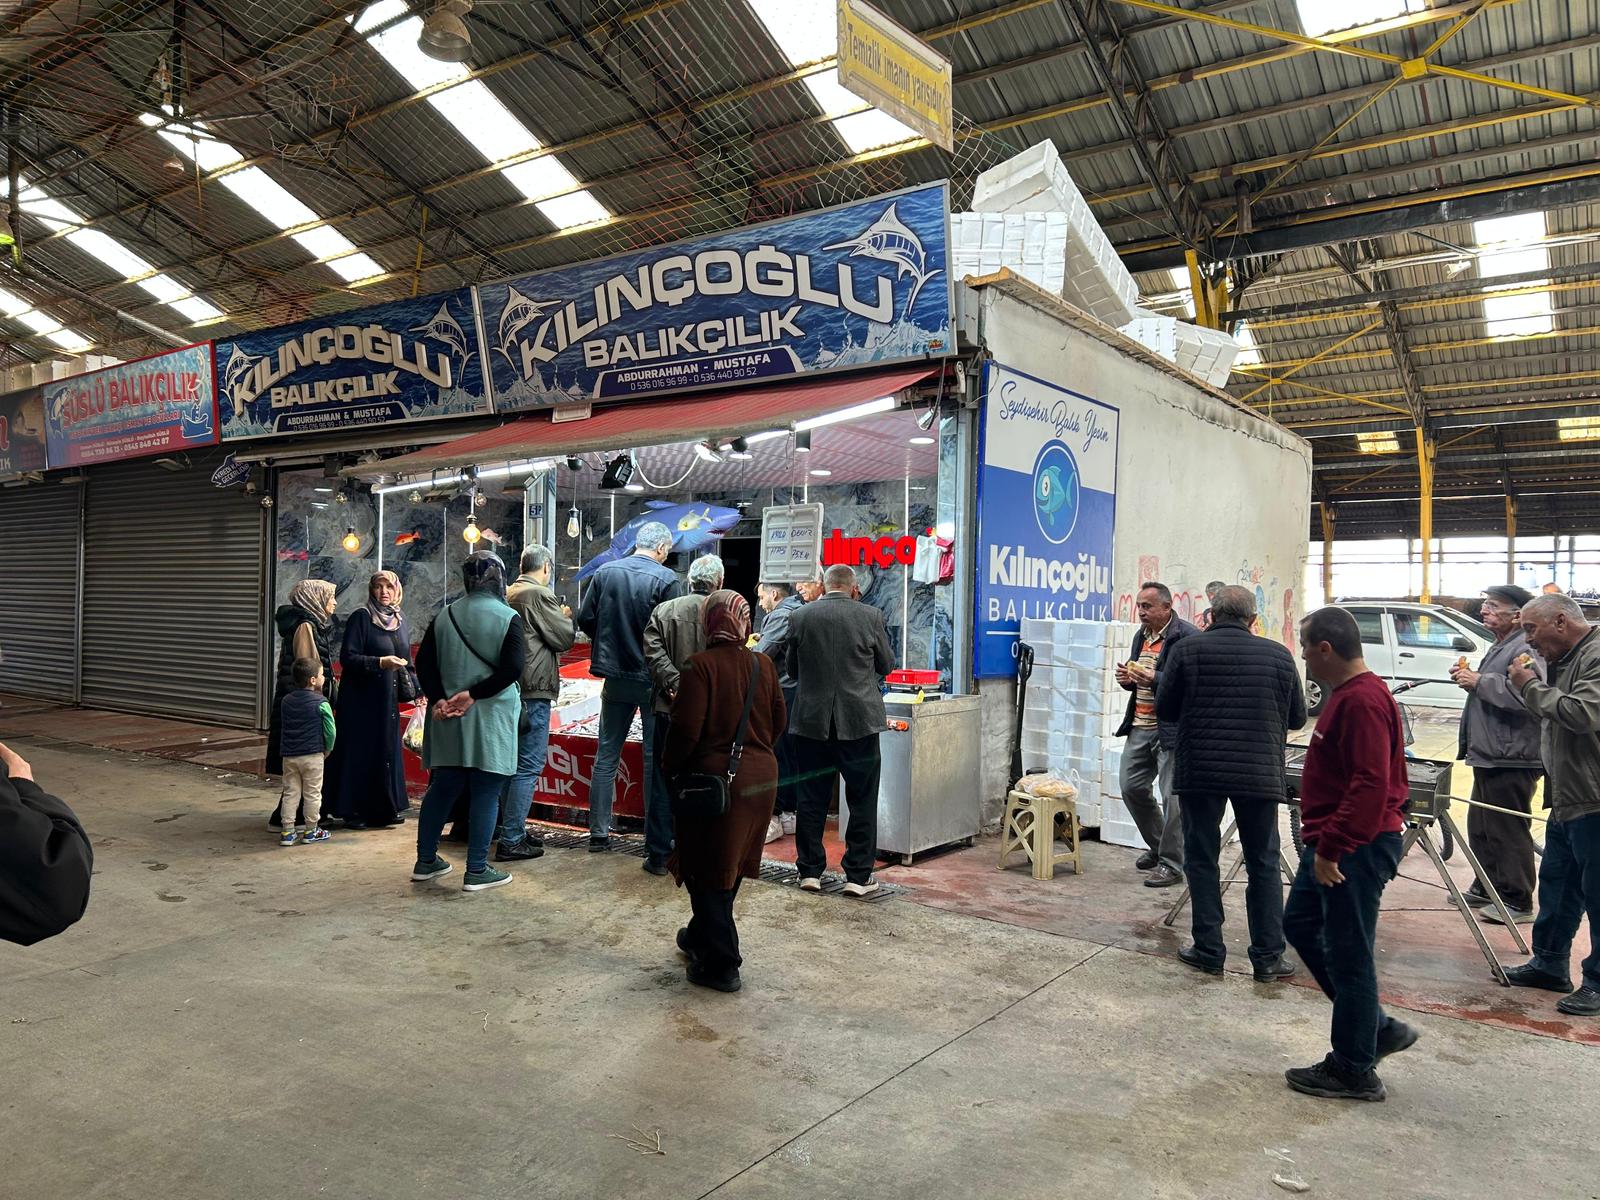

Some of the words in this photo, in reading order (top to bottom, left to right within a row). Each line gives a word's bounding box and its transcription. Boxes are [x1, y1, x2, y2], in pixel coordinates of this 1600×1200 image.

[847, 22, 881, 75] Temizlik
[520, 245, 893, 381] KILINÇOĞLU
[584, 305, 806, 368] BALIKÇILIK
[235, 324, 452, 417] KILINÇOĞLU
[271, 370, 402, 408] BALIKÇILIK
[617, 363, 699, 383] ABDURRAHMAN
[714, 353, 771, 371] MUSTAFA
[630, 382, 635, 390] 0
[637, 380, 651, 389] 536
[652, 379, 665, 388] 016
[666, 377, 676, 387] 96
[677, 376, 688, 385] 99
[694, 374, 700, 383] 0
[701, 373, 716, 382] 536
[717, 370, 733, 380] 440
[734, 368, 745, 378] 90
[747, 367, 757, 376] 52
[64, 378, 105, 427] SÜSLÜ
[109, 372, 199, 412] BALIKÇILIK
[287, 412, 341, 426] ABDURRAHMAN
[344, 411, 350, 420] &
[353, 407, 392, 419] MUSTAFA
[1083, 409, 1109, 453] Yesin
[989, 543, 1109, 602] Kılınçoğlu
